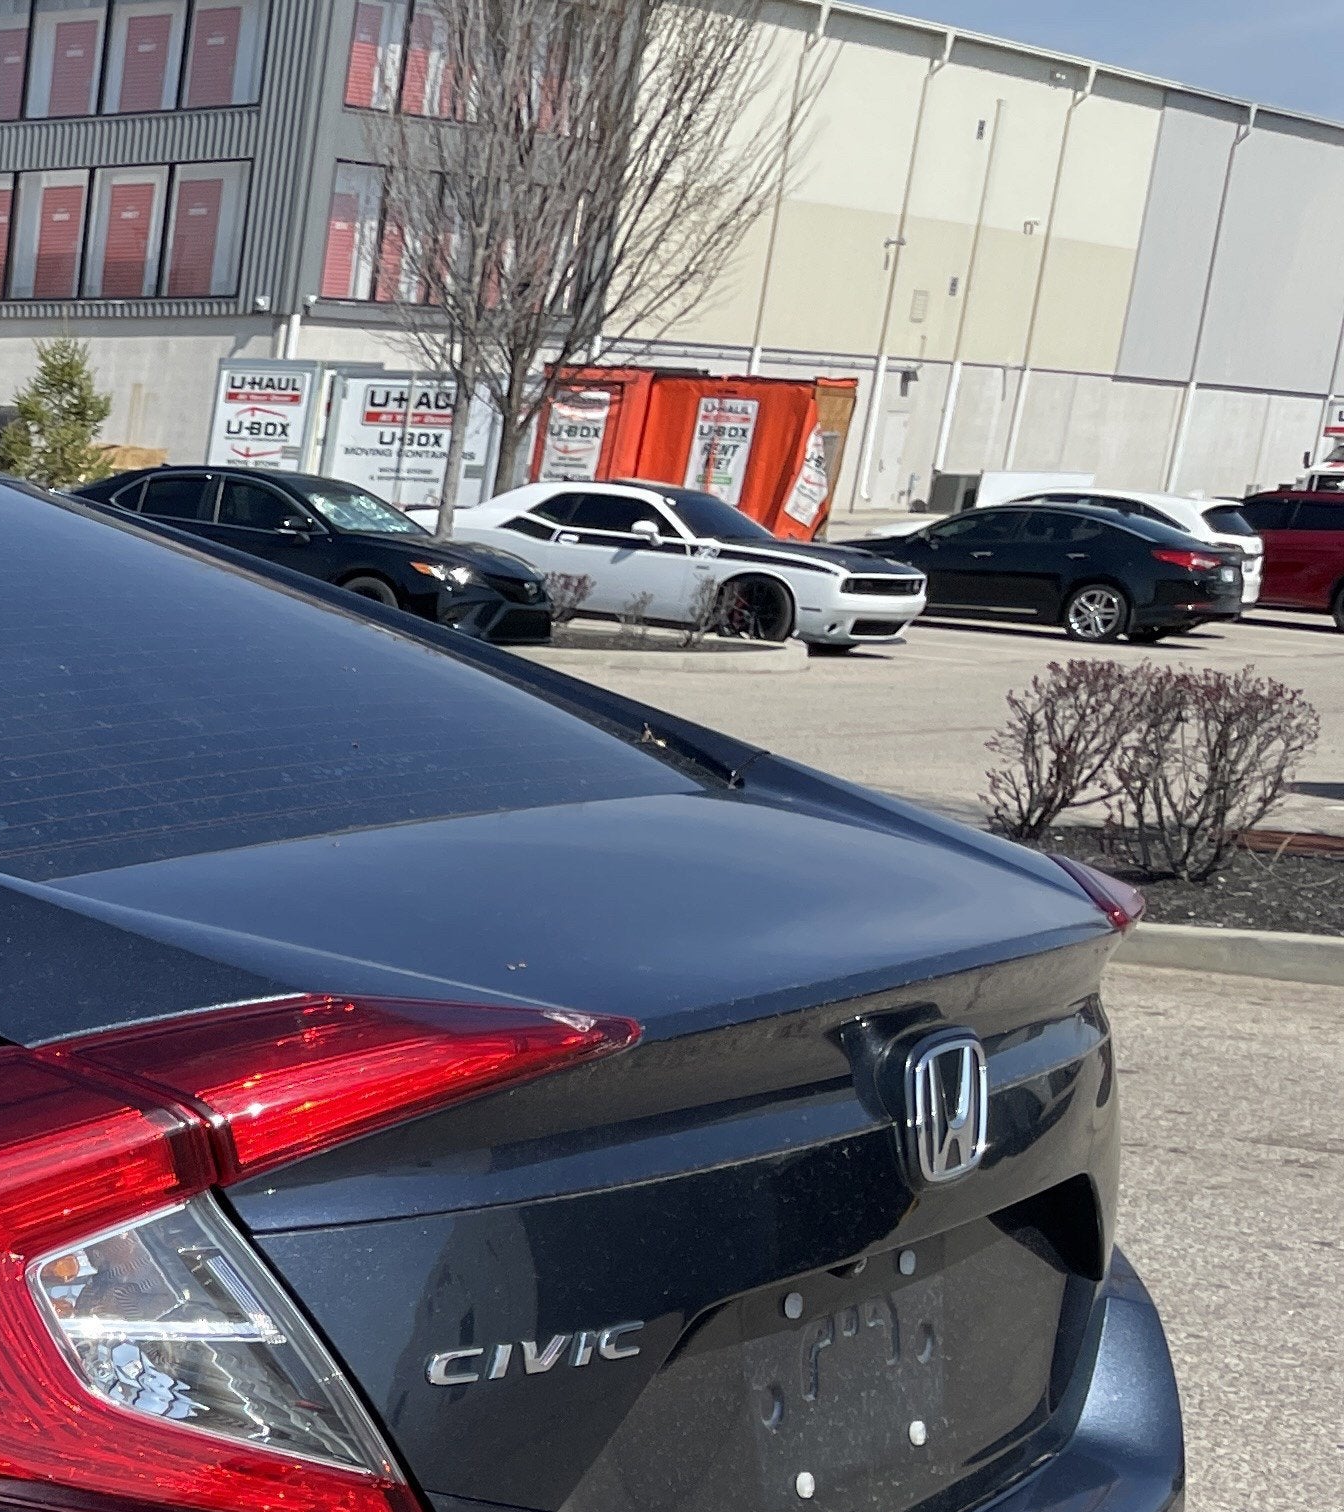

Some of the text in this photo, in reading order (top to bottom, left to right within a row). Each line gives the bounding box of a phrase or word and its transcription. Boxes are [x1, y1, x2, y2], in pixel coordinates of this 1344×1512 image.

[230, 376, 300, 391] U-HAUL
[226, 421, 290, 437] U-BOX
[425, 1320, 645, 1386] CIVIC
